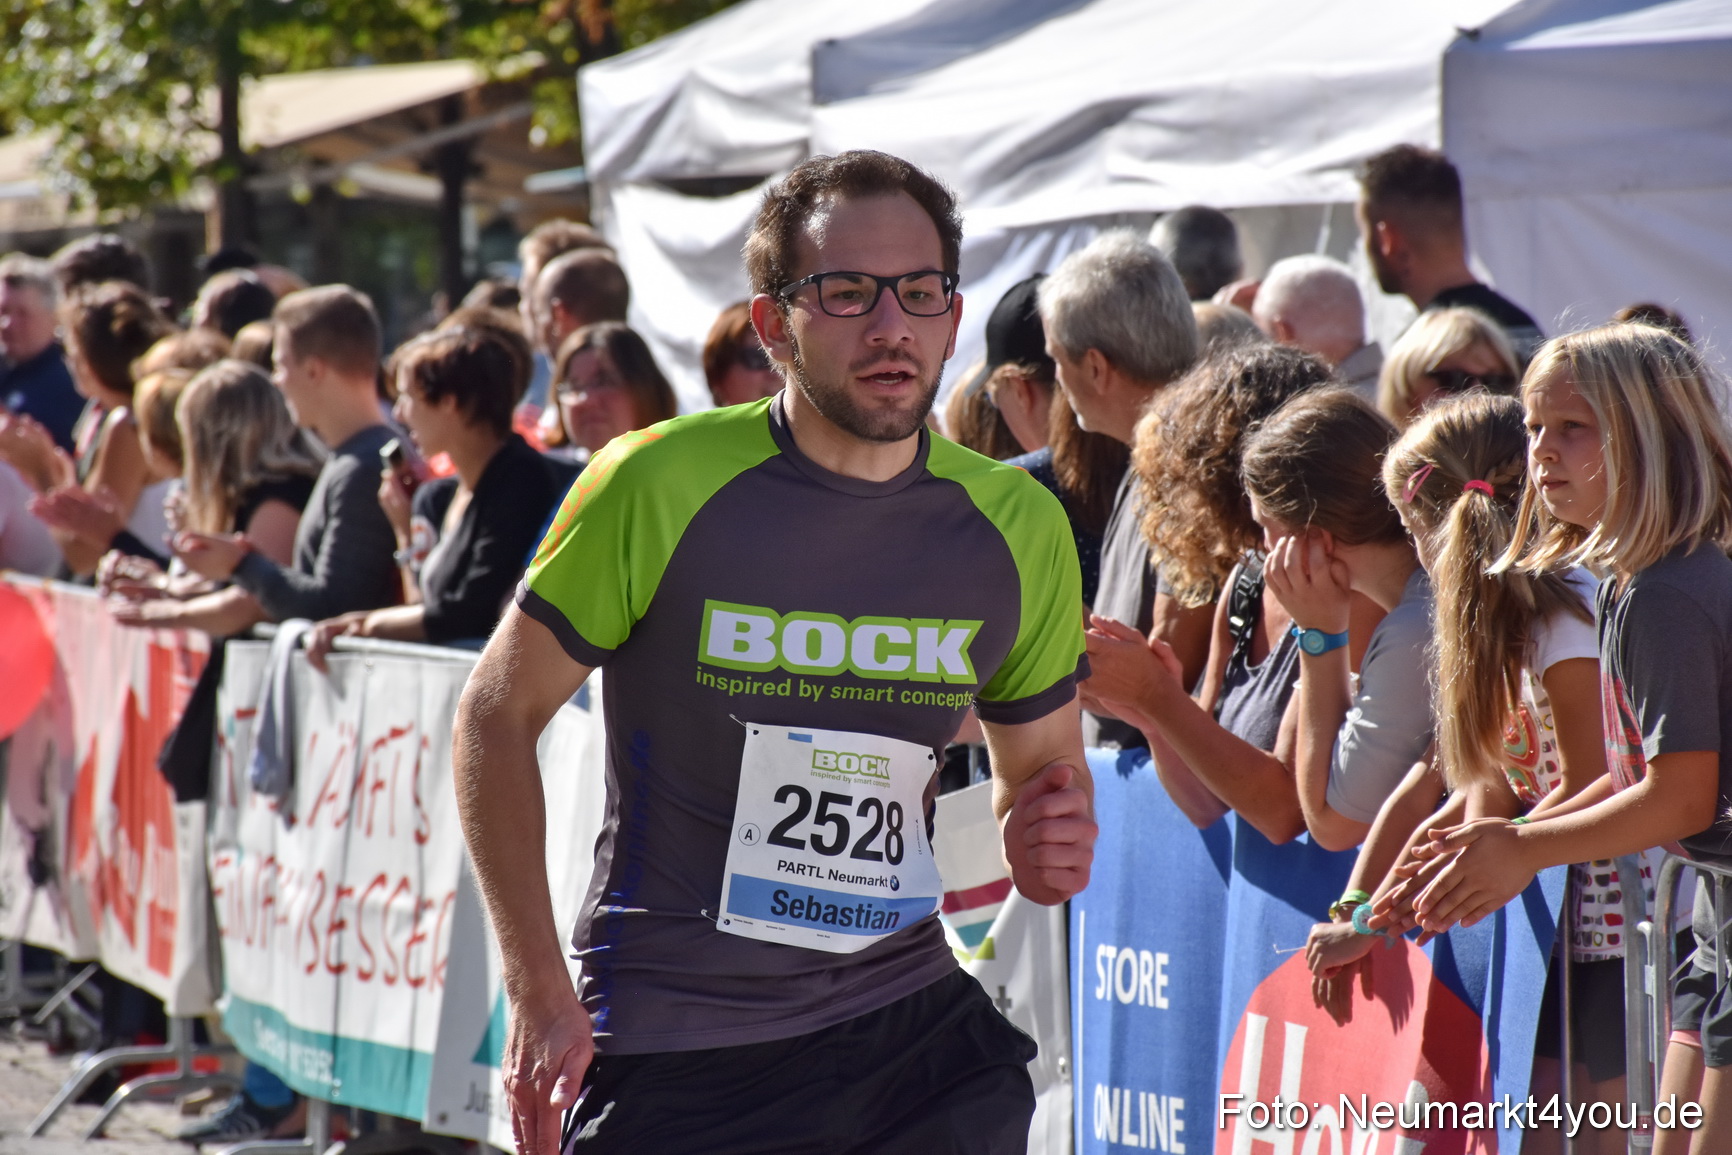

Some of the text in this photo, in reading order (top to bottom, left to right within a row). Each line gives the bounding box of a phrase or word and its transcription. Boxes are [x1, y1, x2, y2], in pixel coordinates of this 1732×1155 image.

[701, 603, 980, 681] BOCK
[696, 666, 974, 711] inspired by smart concepts
[810, 769, 841, 781] inspired
[843, 775, 852, 784] by
[812, 749, 890, 779] BOCK
[744, 828, 753, 841] A
[766, 784, 905, 866] 2528
[777, 859, 889, 888] PARTL Neumarkt
[770, 889, 900, 930] Sebastian
[1095, 943, 1169, 1010] STORE
[1093, 1082, 1186, 1155] ONLINE
